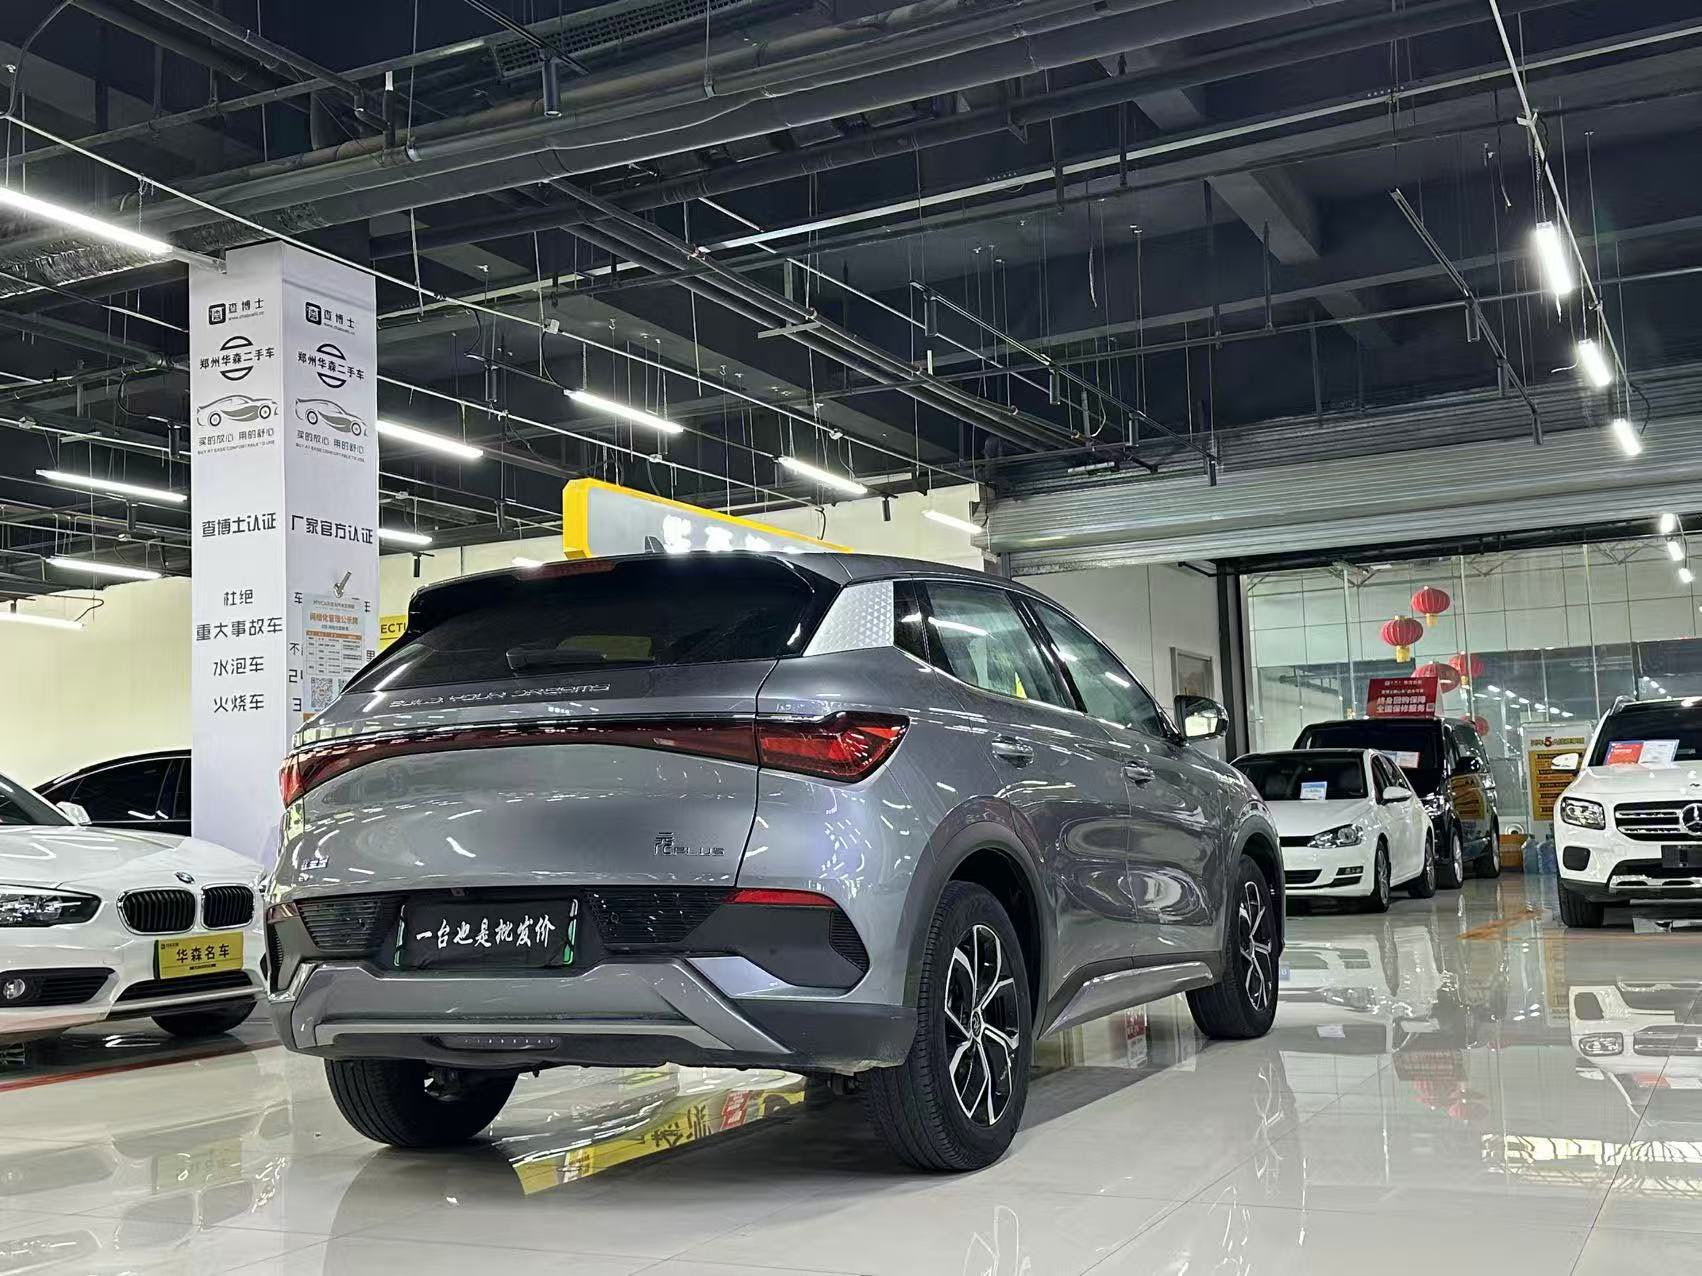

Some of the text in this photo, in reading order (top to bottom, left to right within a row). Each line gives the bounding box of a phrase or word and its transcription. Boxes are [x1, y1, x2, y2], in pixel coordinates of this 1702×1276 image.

[228, 298, 264, 314] 查博士
[323, 309, 355, 329] 查博士
[200, 347, 275, 370] 郑州华森二手车
[297, 351, 365, 381] 郑州华森二手车
[199, 428, 275, 446] 买的放心 用的舒心
[297, 430, 329, 446] 买的放心
[202, 513, 277, 538] 查博士认证
[291, 514, 374, 545] 厂家官方认证
[223, 589, 254, 606] 杜绝
[196, 617, 283, 642] 重大事故车
[213, 656, 265, 677] 水泡车
[213, 693, 265, 713] 火烧车
[415, 914, 556, 949] 一台也是批发价
[176, 944, 230, 964] 华森名车
